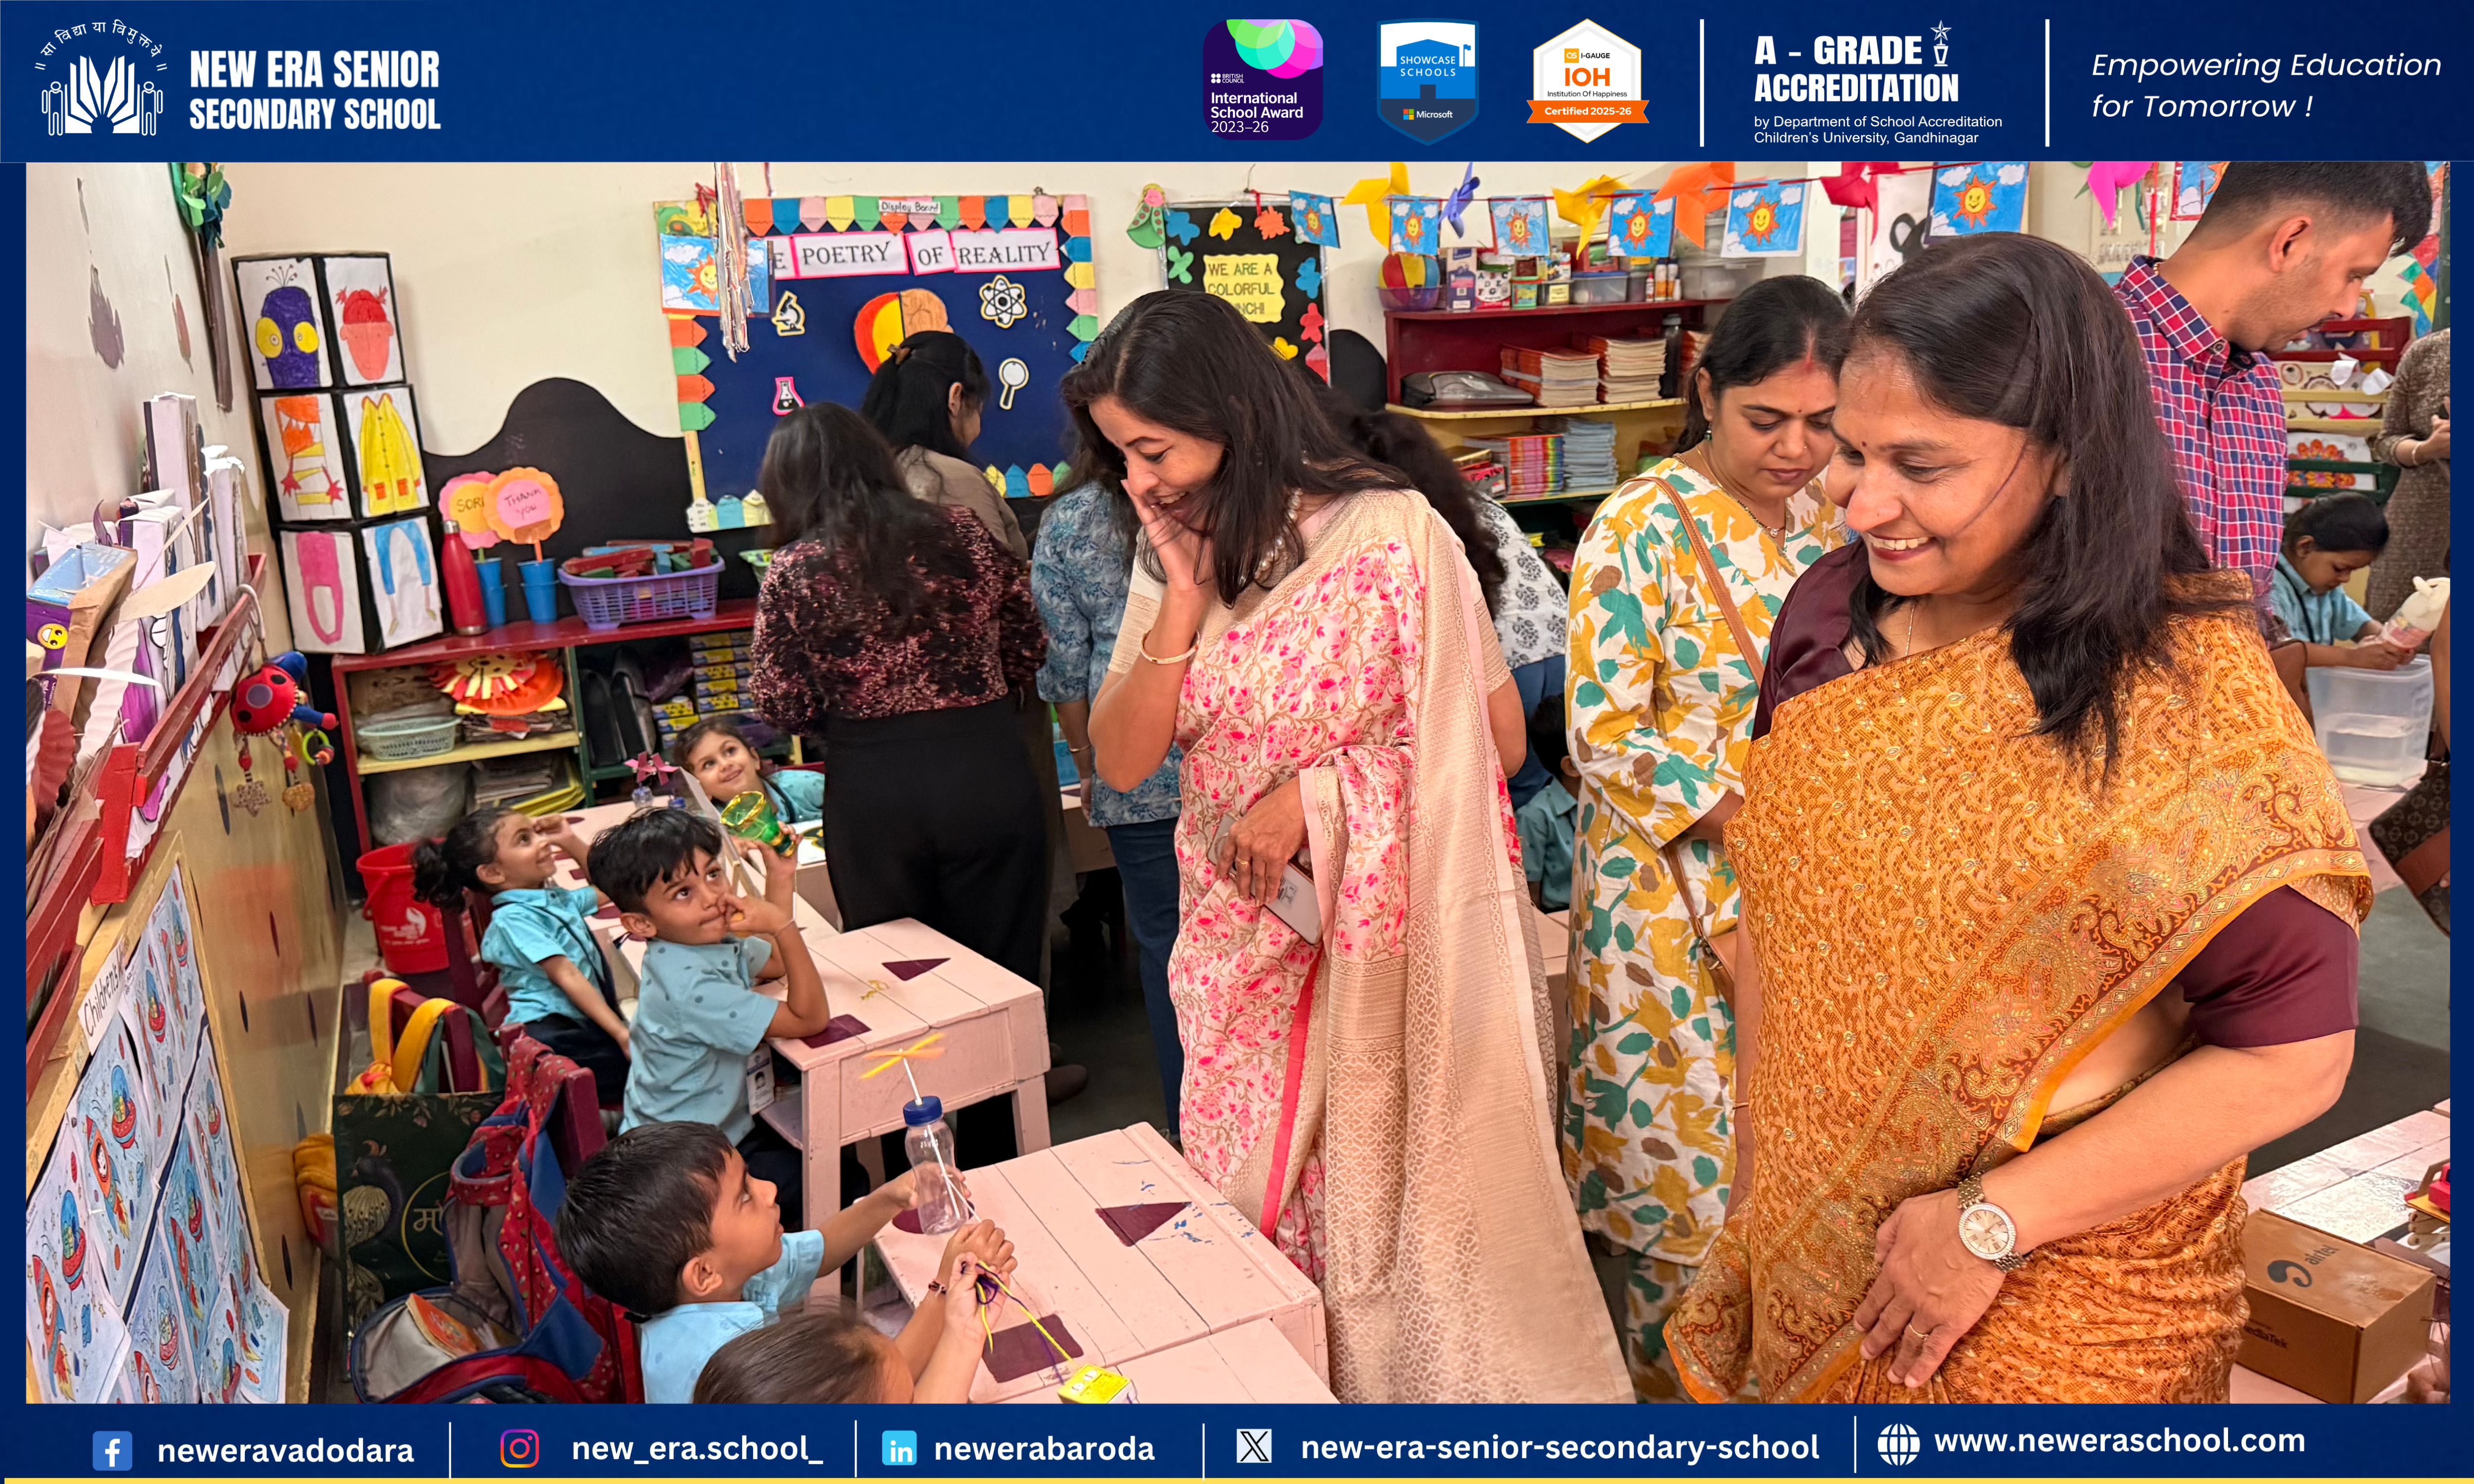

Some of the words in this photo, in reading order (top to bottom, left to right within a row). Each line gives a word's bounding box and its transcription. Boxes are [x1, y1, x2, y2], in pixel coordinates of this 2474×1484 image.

[915, 201, 939, 212] Board
[803, 241, 891, 265] POETRY
[918, 246, 944, 266] OF
[958, 241, 1050, 265] REALITY
[1208, 263, 1229, 276] WE
[1234, 263, 1259, 276] ARE
[1264, 263, 1273, 275] A
[1208, 282, 1275, 296] COLORFUL
[2304, 1244, 2339, 1265] airtel
[2243, 1325, 2287, 1348] ediaTek
